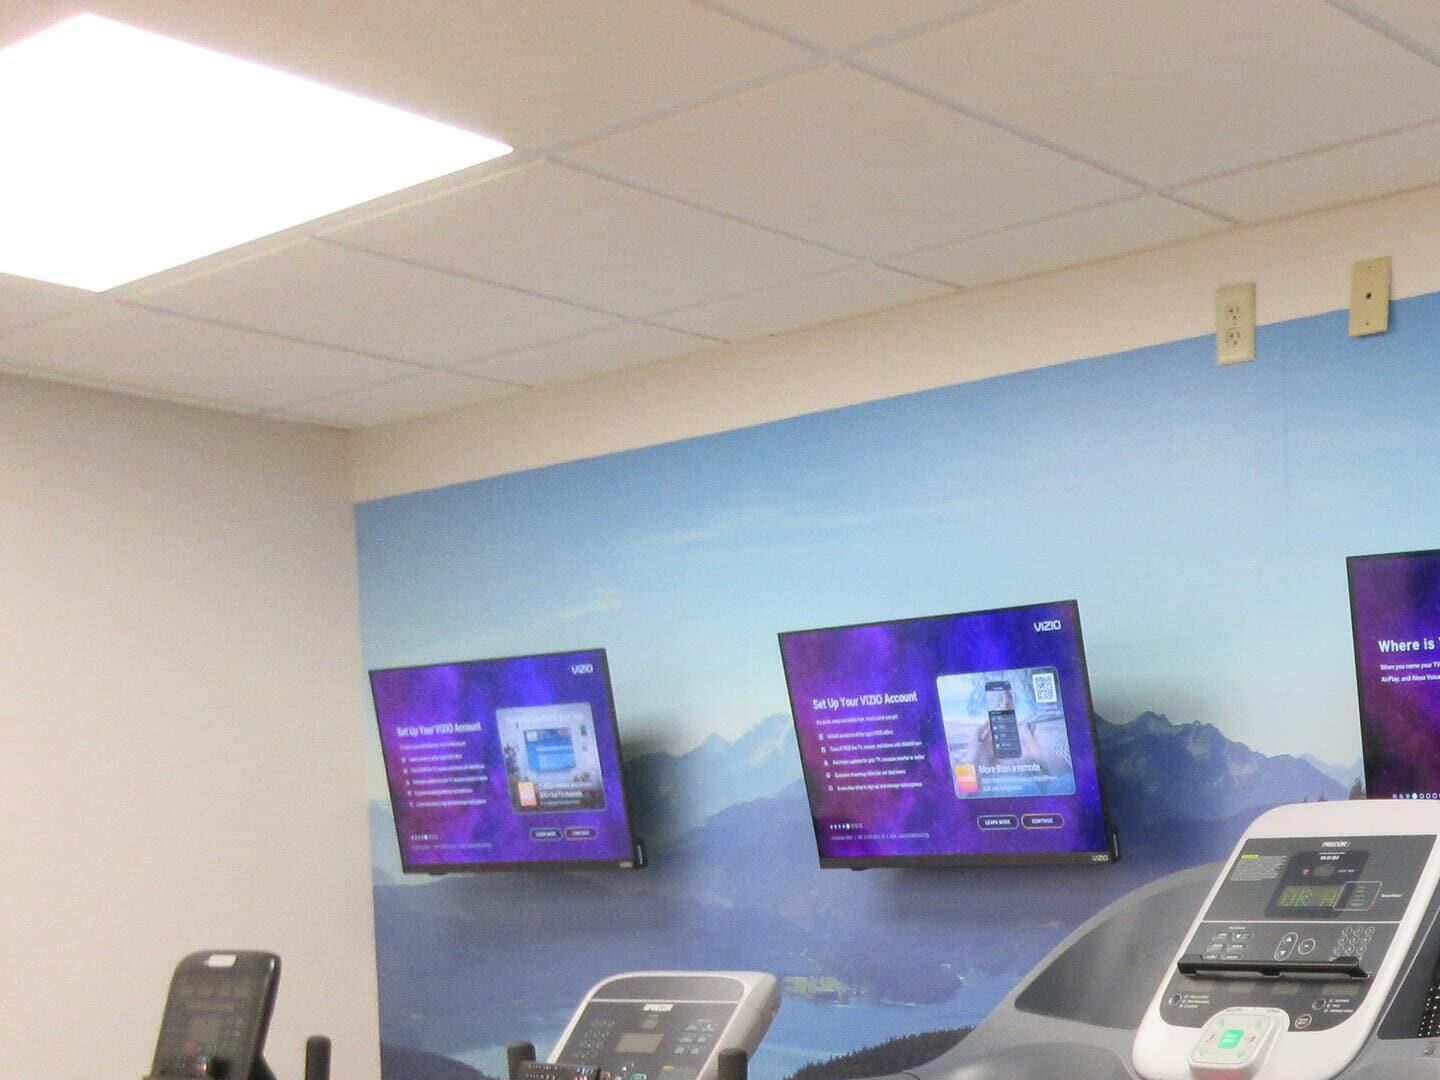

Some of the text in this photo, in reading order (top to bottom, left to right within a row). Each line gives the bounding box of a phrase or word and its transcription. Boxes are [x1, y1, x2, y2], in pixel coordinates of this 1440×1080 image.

[1033, 619, 1062, 632] VIZIO
[1378, 640, 1420, 652] Where
[1423, 638, 1435, 650] is
[813, 690, 918, 711] Set Up Your VIZIO Account
[979, 764, 996, 773] More
